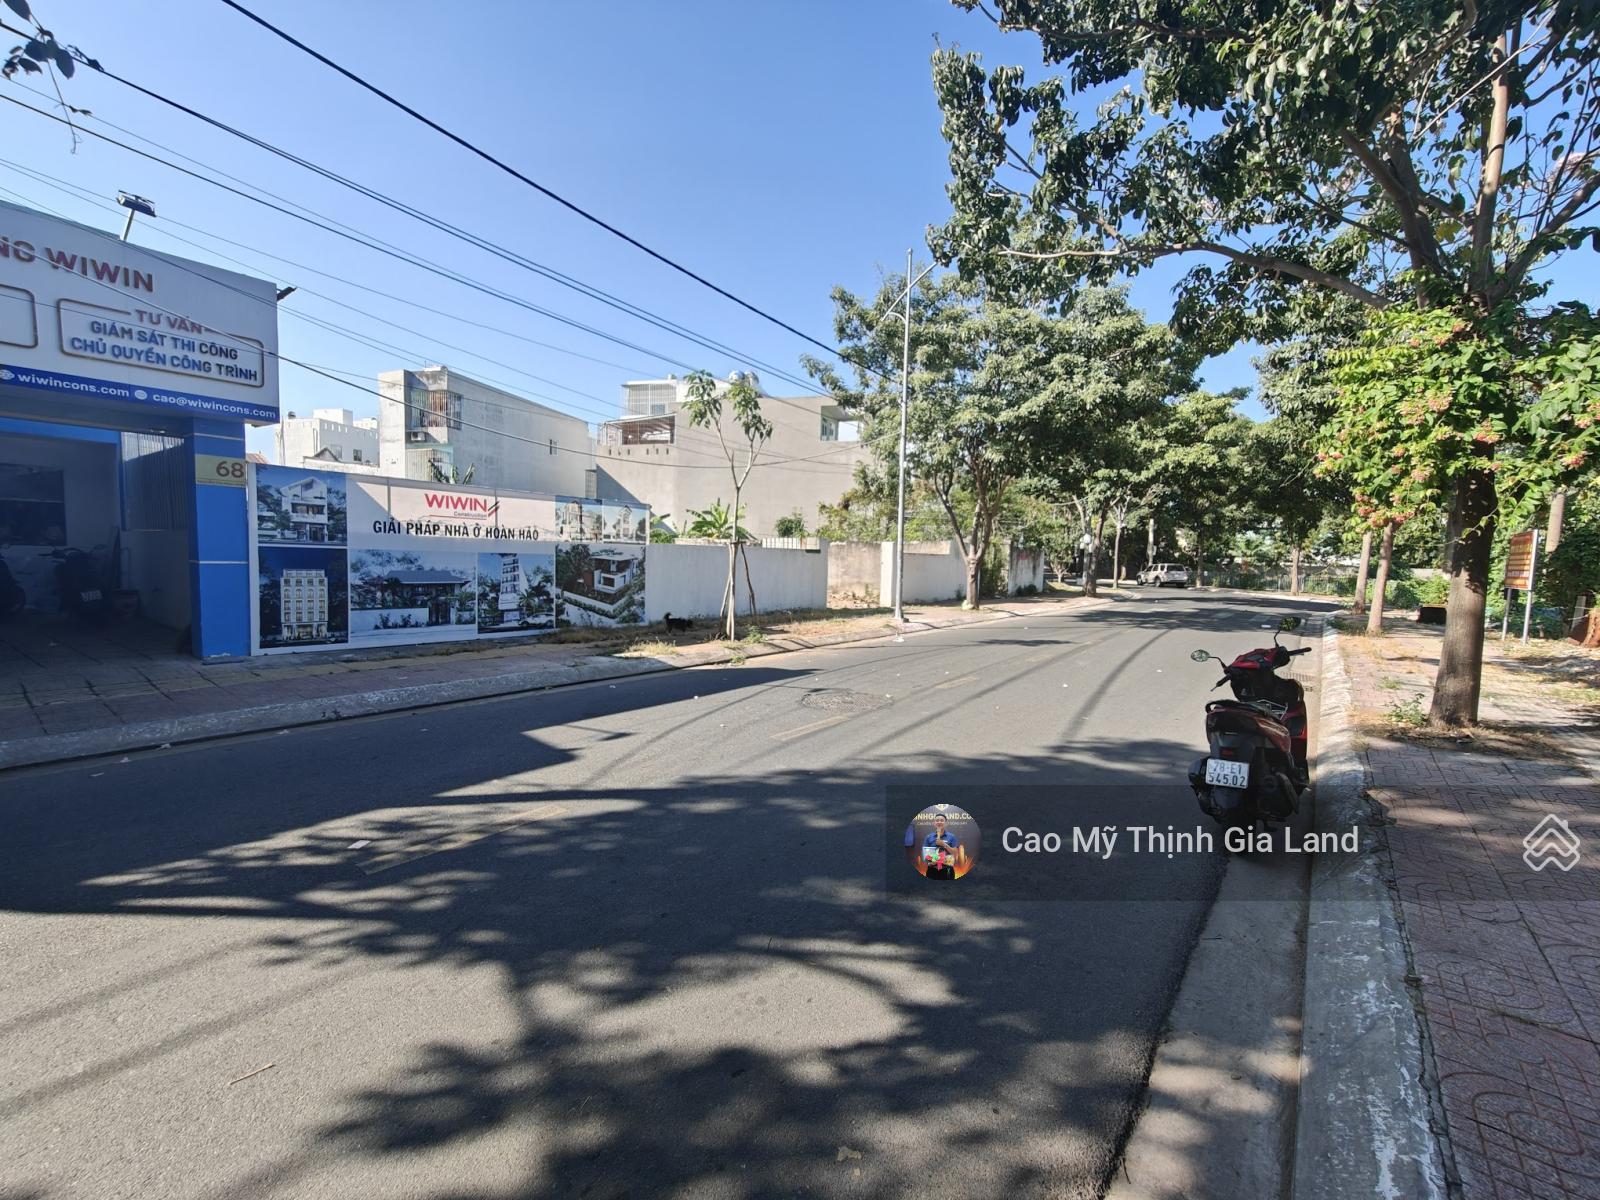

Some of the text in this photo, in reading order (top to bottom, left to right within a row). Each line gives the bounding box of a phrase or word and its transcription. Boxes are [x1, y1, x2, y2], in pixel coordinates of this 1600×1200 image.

[44, 247, 154, 292] WIWIN
[135, 309, 163, 325] TƯ
[90, 320, 239, 360] GIÁM SÁT THI CÔNG
[71, 337, 107, 355] CHỦ
[170, 354, 212, 374] CÔNG
[215, 363, 258, 382] TRÌNH
[17, 374, 276, 420] wiwincons.com cao@wiwincons.com
[216, 460, 245, 478] 68
[424, 493, 487, 512] WIWIN
[373, 517, 401, 534] GIẢI
[406, 520, 440, 536] PHÁP
[444, 522, 470, 537] NHÀ
[486, 523, 515, 540] HOÀN
